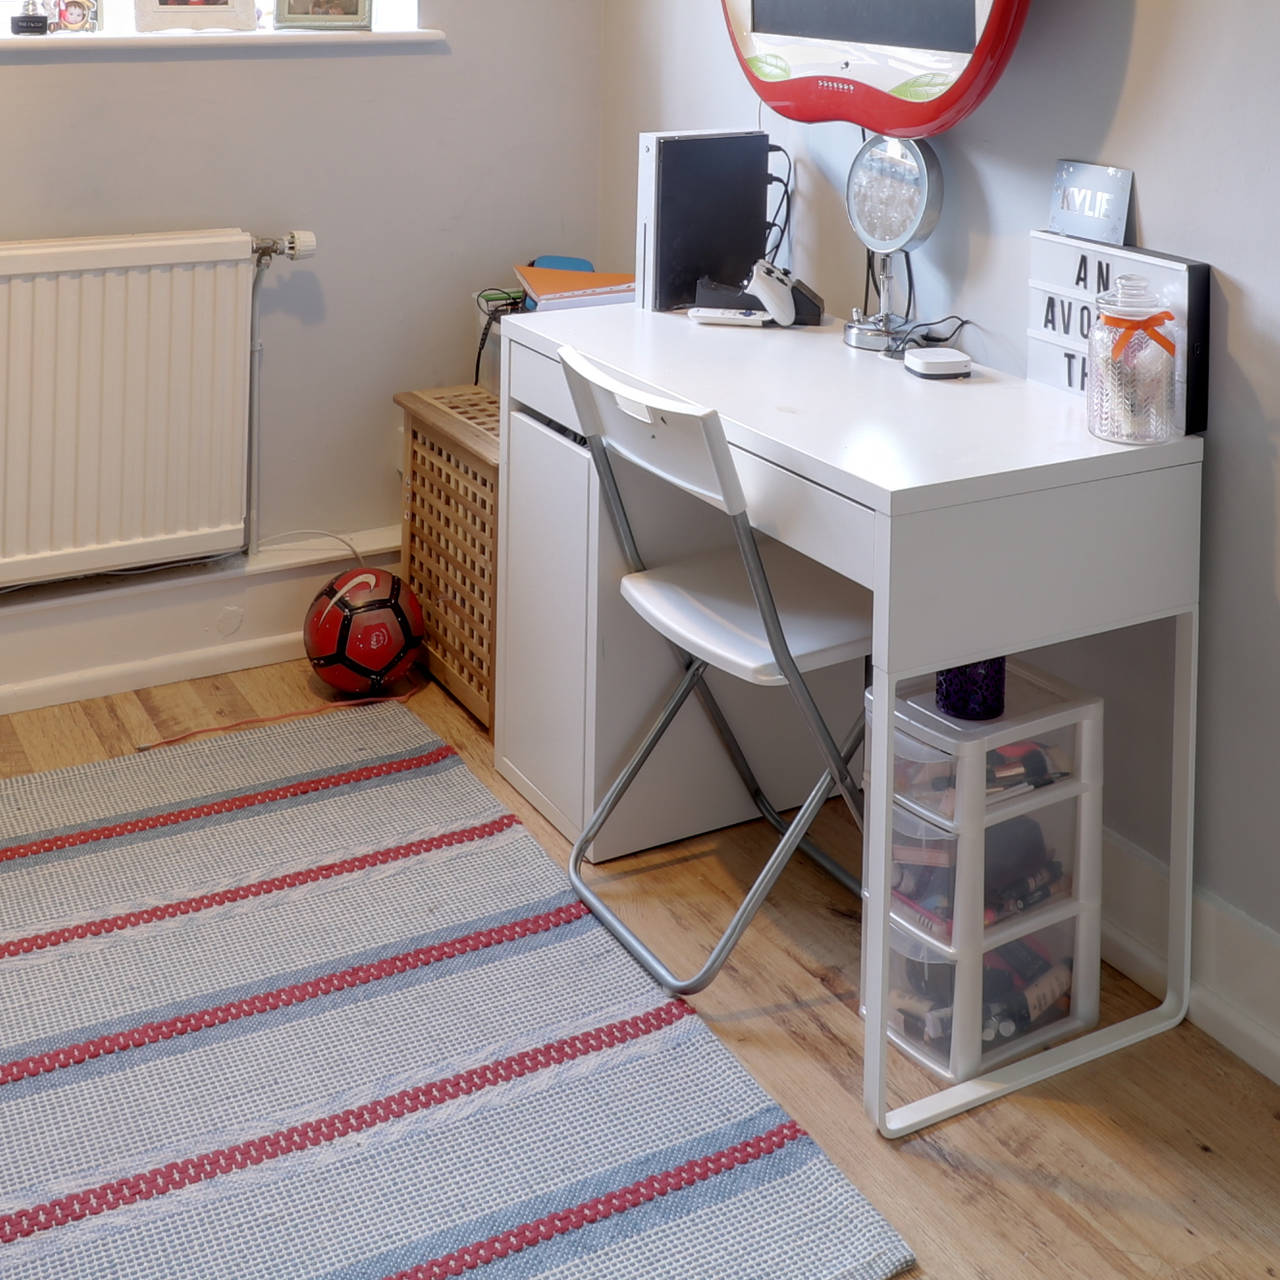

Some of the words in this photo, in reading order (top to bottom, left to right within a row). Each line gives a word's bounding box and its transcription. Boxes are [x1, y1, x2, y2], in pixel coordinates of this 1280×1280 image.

[1060, 187, 1113, 219] KYLIE
[1075, 254, 1110, 293] AN
[1043, 296, 1100, 340] AVO
